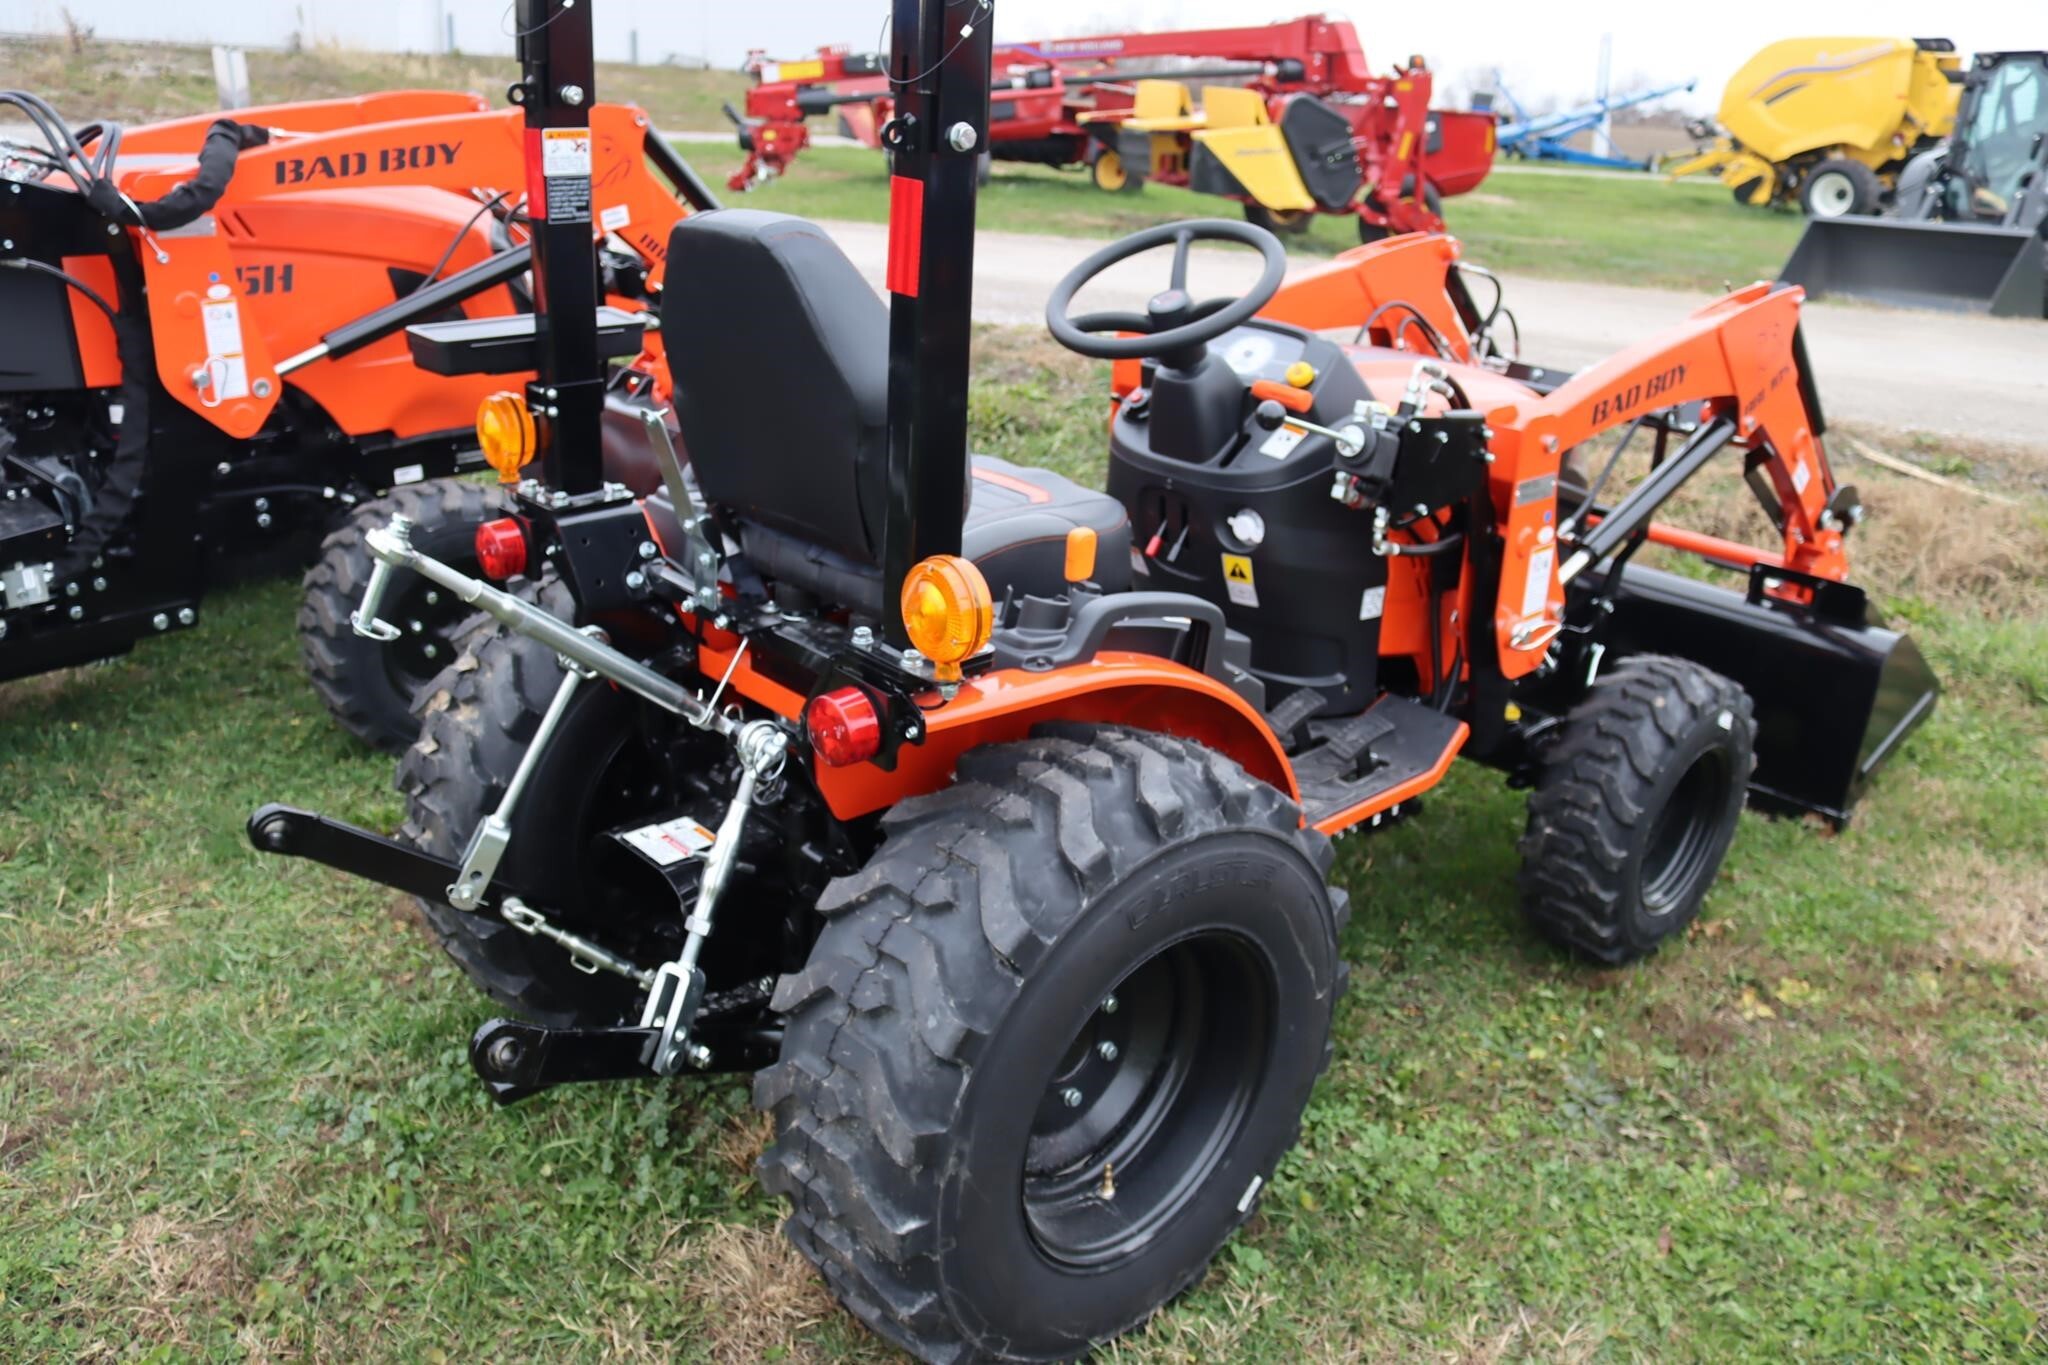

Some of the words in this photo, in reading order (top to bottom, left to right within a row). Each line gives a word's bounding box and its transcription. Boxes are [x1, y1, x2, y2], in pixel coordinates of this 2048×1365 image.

[275, 152, 367, 185] BAD
[379, 141, 463, 172] BOY
[1592, 384, 1642, 426] BAD
[1645, 361, 1690, 399] BOY
